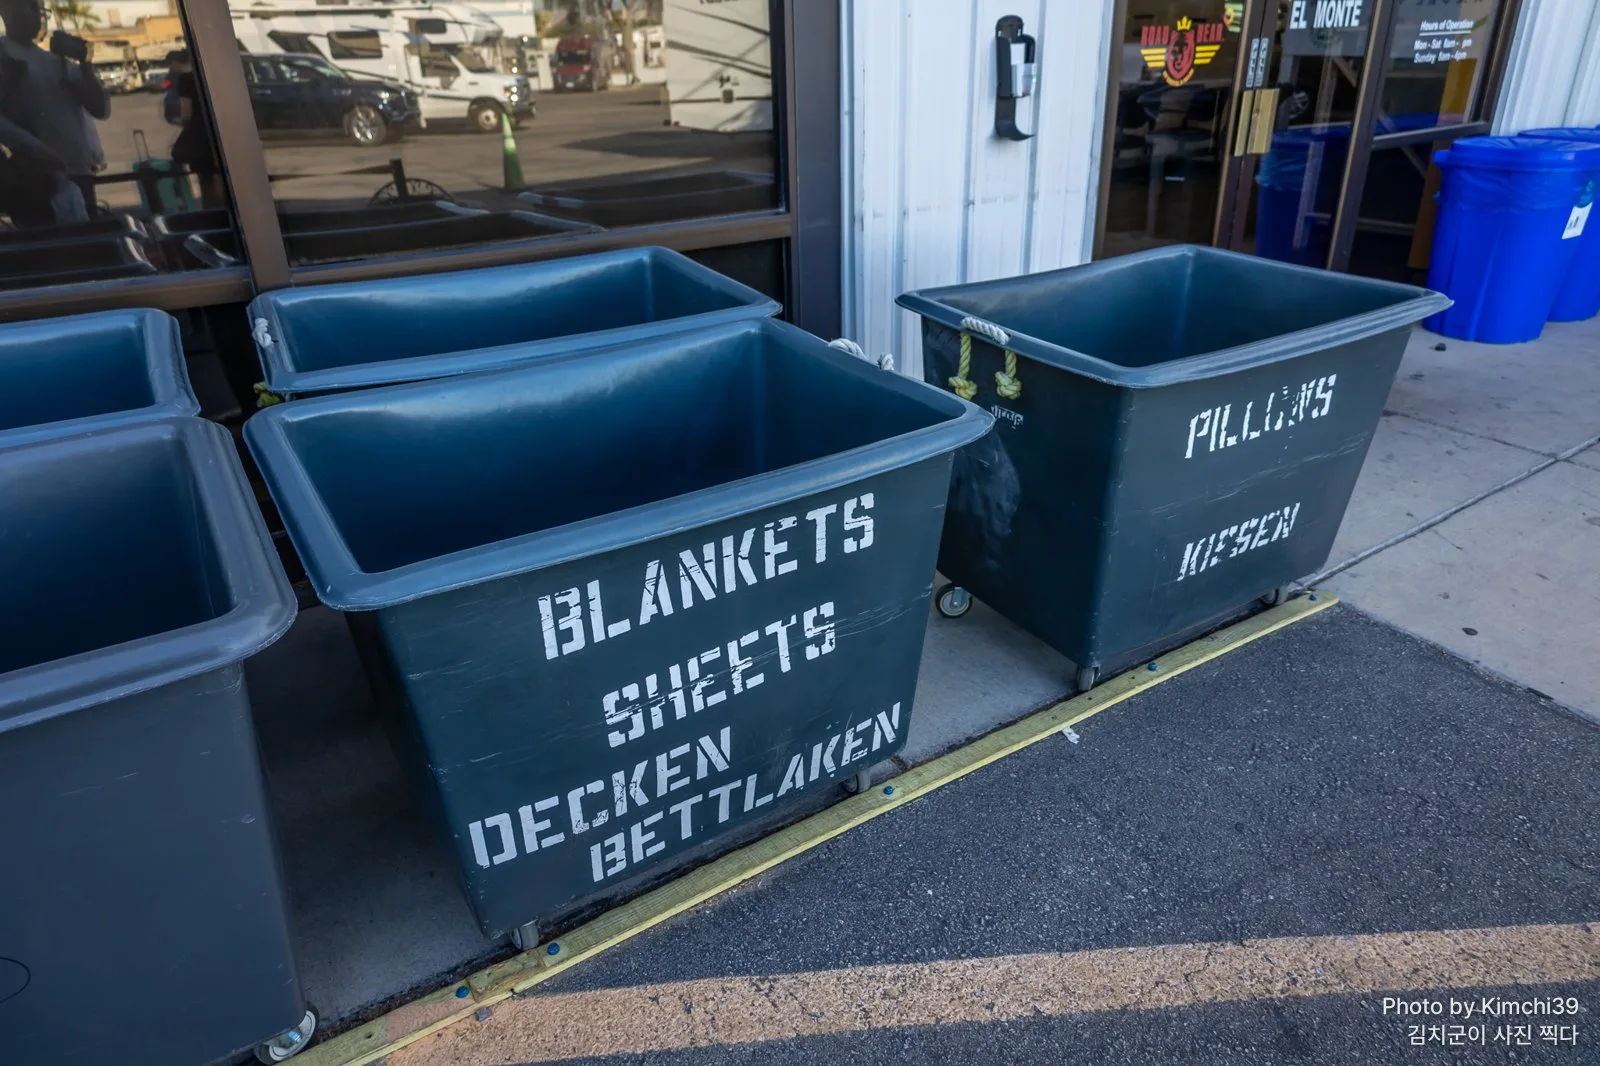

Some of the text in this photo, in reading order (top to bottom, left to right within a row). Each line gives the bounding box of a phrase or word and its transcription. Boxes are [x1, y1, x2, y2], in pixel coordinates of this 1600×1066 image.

[1140, 24, 1170, 46] ROAD
[1289, 0, 1363, 29] EL MONTE
[1420, 19, 1474, 31] Hours of Operation
[1414, 52, 1436, 64] Sunday
[536, 492, 875, 660] BLANKETS
[602, 601, 836, 748] SHEETS
[468, 726, 732, 869] DECKEN
[590, 701, 902, 883] BETTLAKEN
